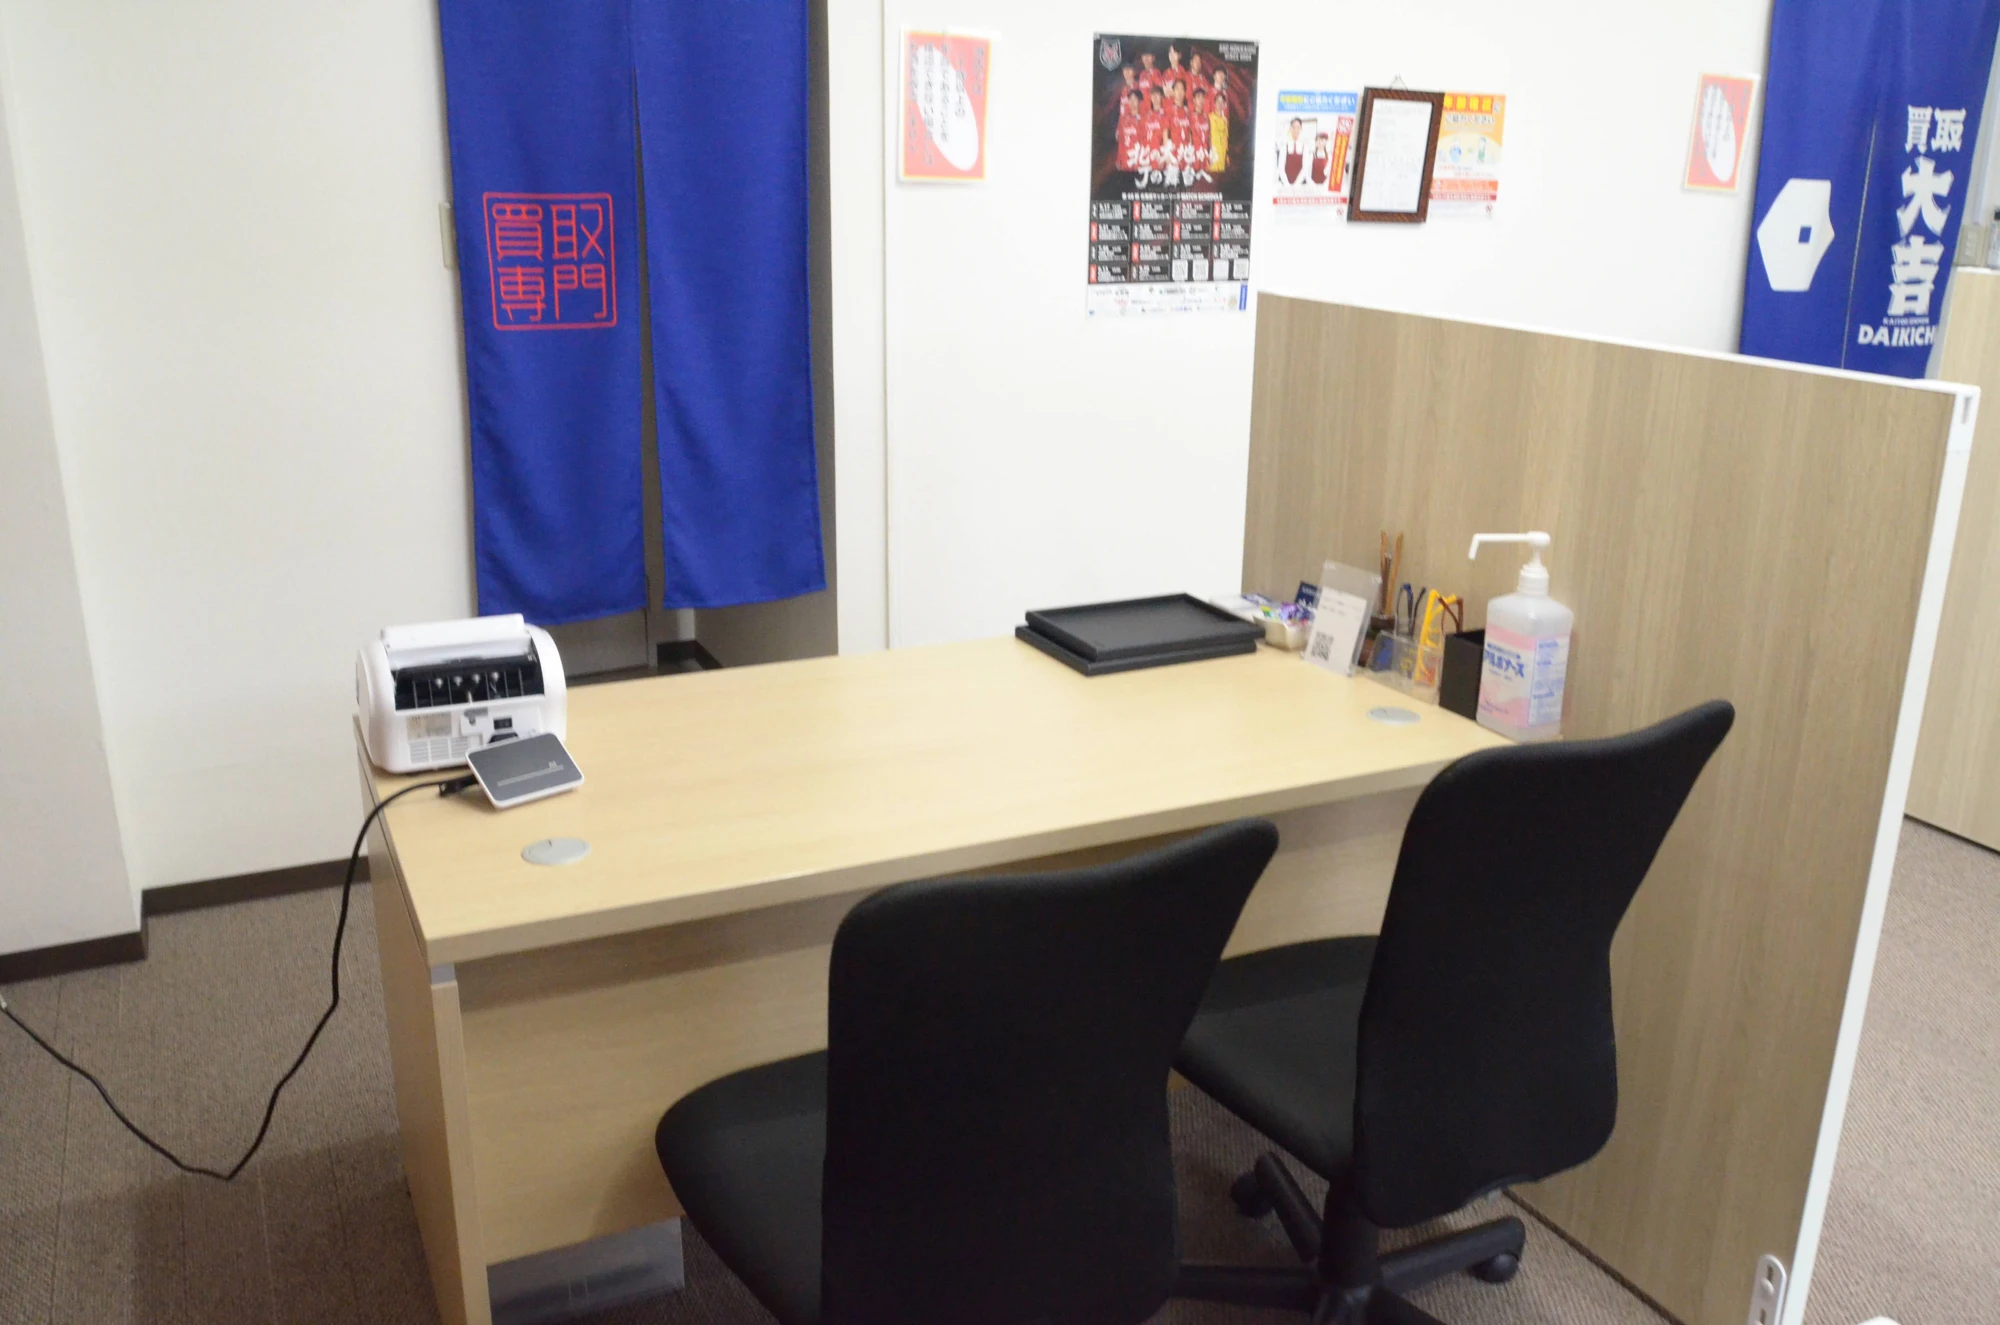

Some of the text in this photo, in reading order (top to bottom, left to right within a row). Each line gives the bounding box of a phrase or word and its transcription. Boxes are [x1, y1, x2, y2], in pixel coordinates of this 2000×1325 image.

[1905, 104, 1966, 153] 買取
[1126, 139, 1219, 168] 北の大地から
[1887, 155, 1954, 316] 大吉
[1858, 323, 1936, 347] DAIKICH
